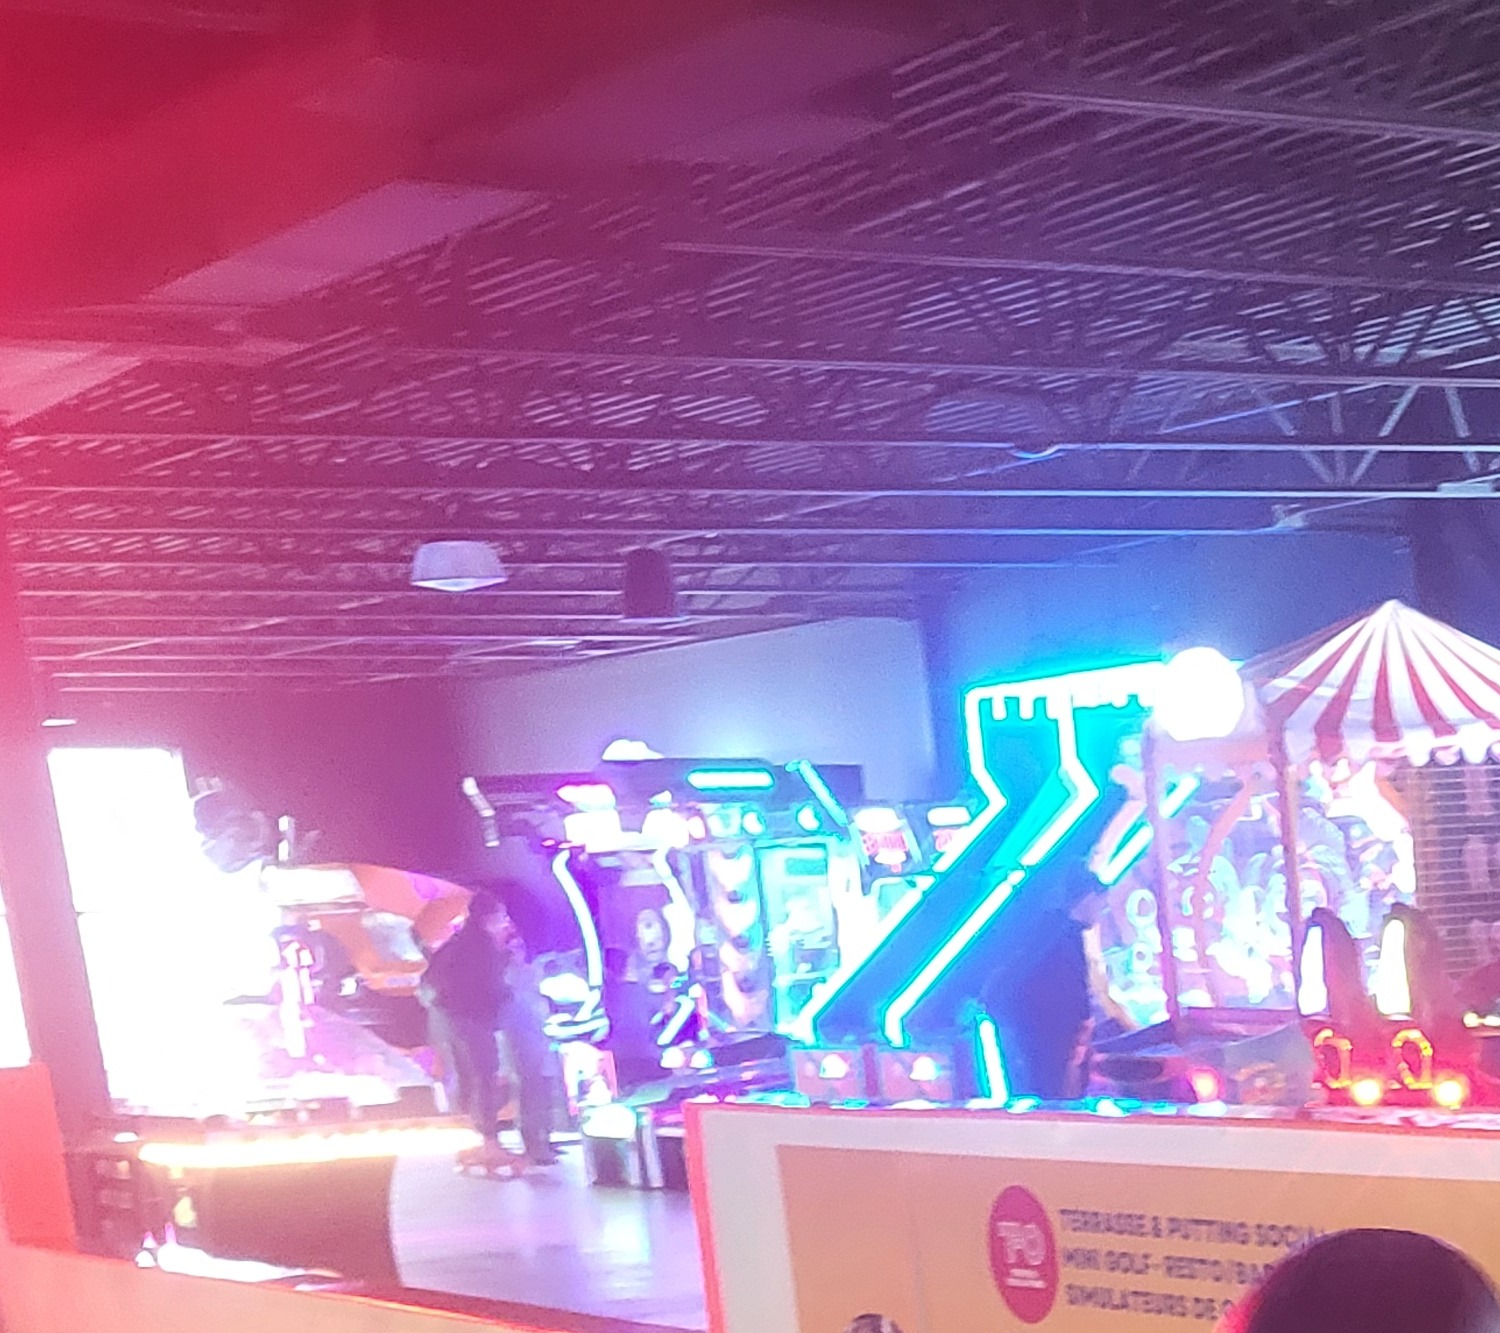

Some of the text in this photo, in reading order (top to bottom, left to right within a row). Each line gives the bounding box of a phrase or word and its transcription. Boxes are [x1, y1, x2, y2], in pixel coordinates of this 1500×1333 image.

[1059, 1208, 1149, 1237] TERRASSE
[1165, 1216, 1249, 1246] PUTTING
[1104, 1250, 1151, 1275] GOLF
[1065, 1283, 1187, 1318] SIMULATEURS
